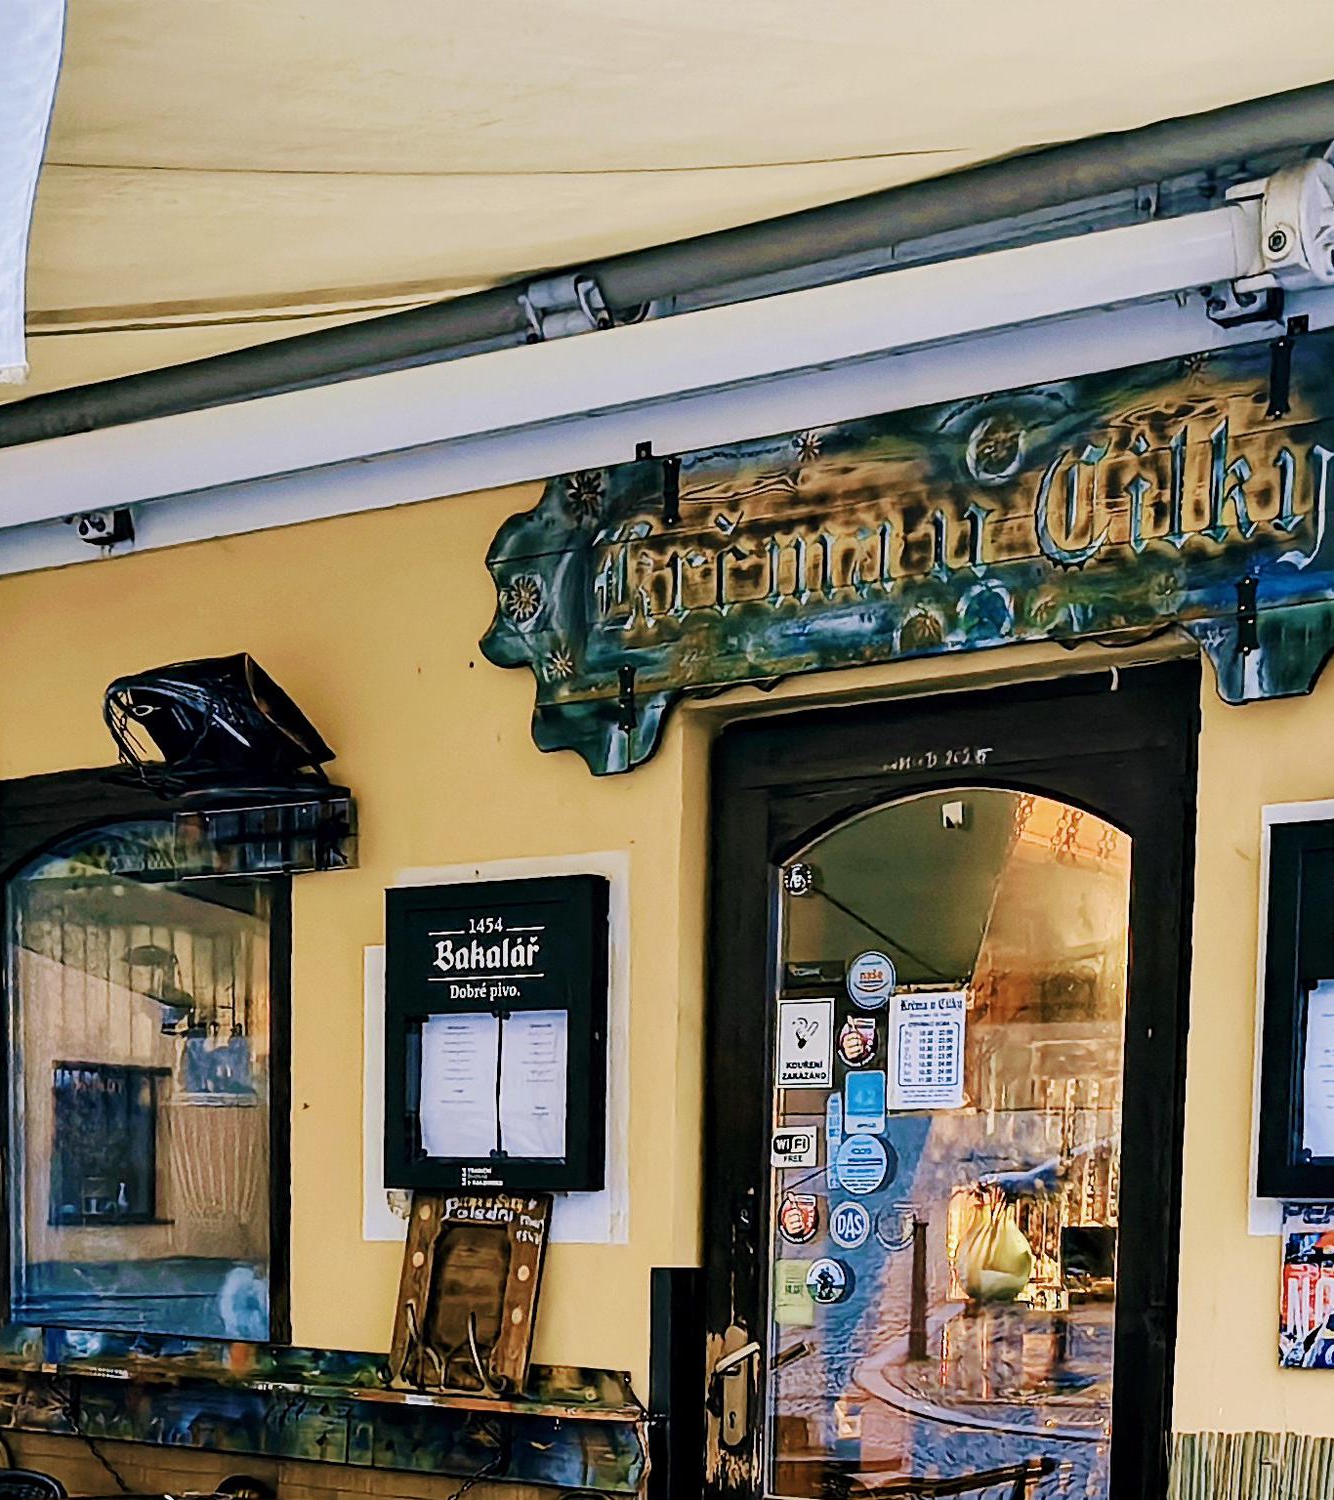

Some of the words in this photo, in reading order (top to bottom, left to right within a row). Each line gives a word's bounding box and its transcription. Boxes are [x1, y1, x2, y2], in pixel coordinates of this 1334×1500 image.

[468, 917, 504, 934] 1454
[433, 936, 540, 972] Bakalář
[449, 982, 487, 999] Dobré
[490, 982, 521, 1001] pivo.
[837, 1212, 863, 1239] DAS
